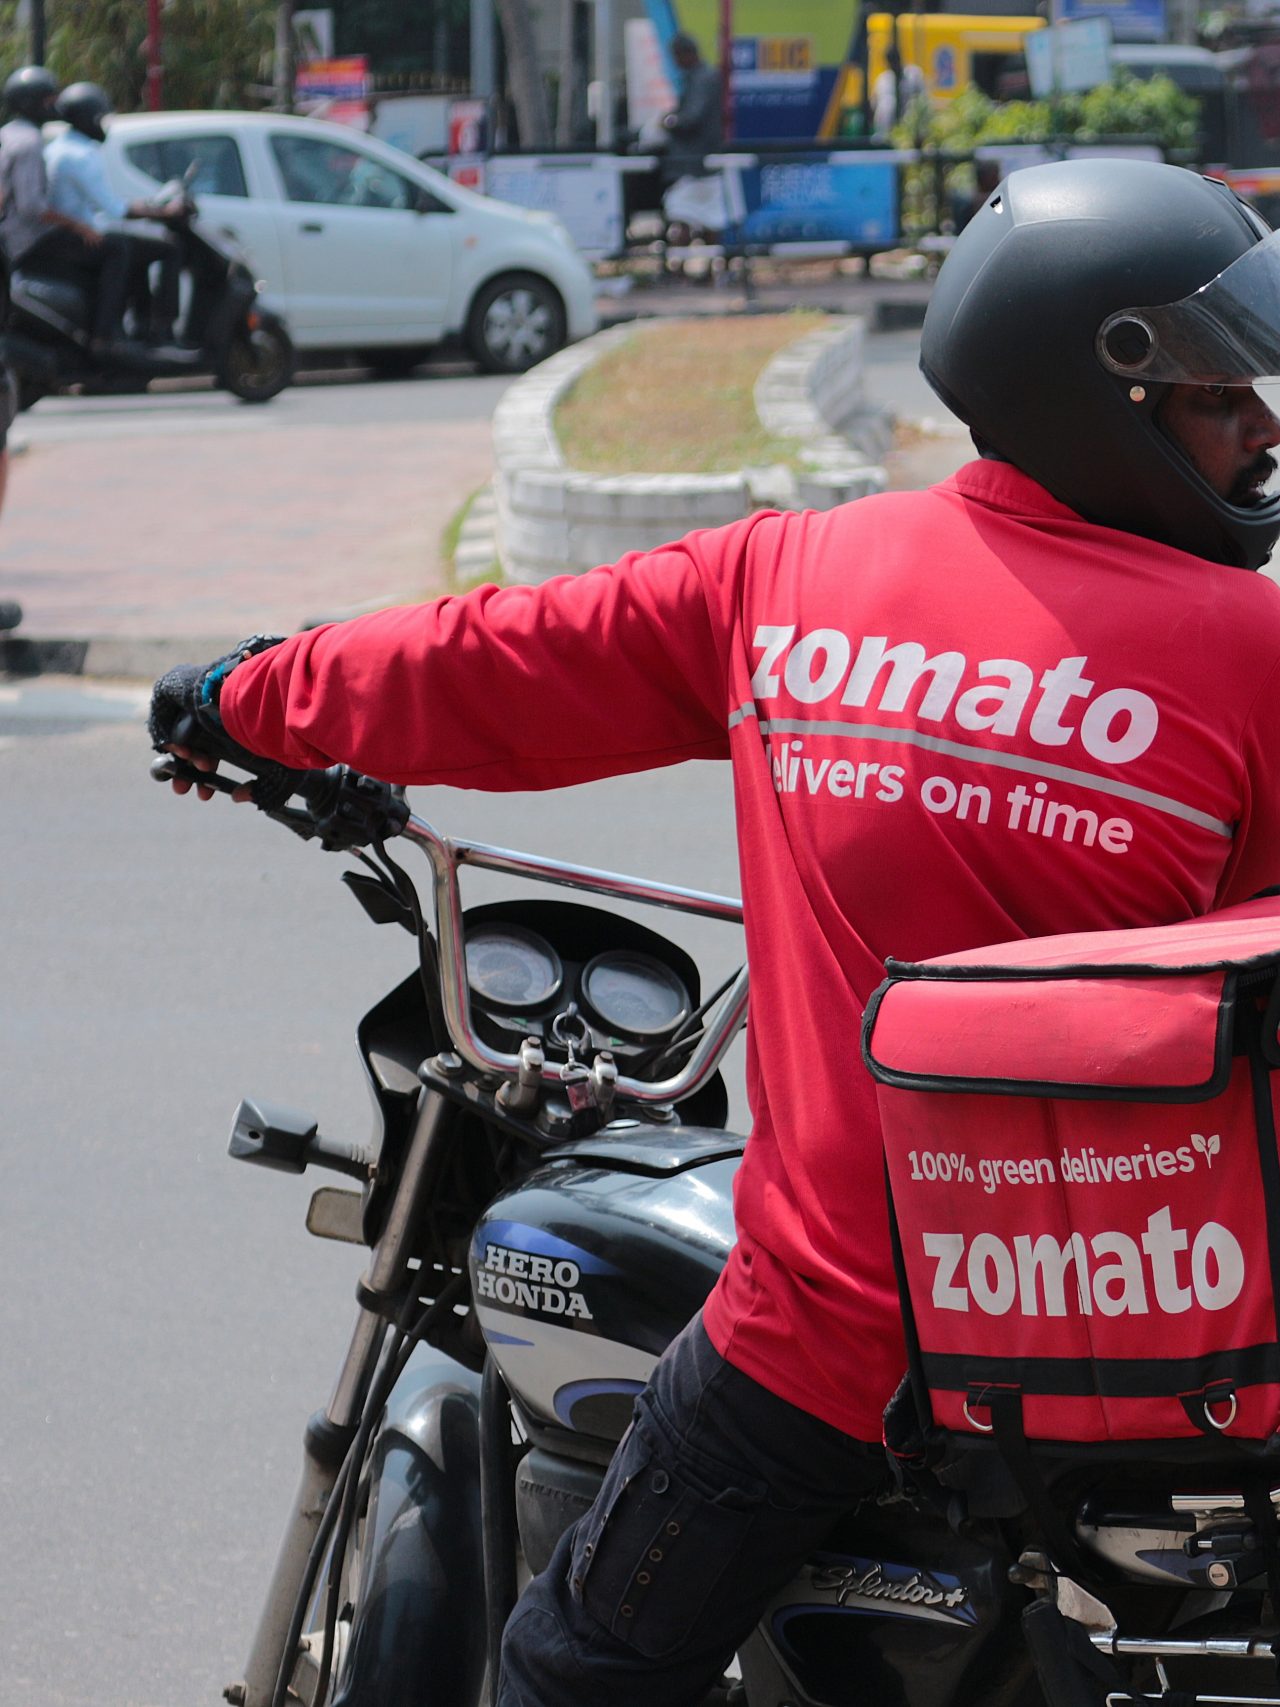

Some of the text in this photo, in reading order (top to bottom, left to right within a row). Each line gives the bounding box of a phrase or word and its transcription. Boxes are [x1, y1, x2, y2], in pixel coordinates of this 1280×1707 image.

[751, 624, 1159, 764] zomato
[766, 740, 1134, 854] elivers on time
[908, 1143, 1195, 1194] 100% green deliveries
[477, 1271, 593, 1320] HONDA
[484, 1245, 580, 1288] HERO
[922, 1205, 1245, 1317] zomato
